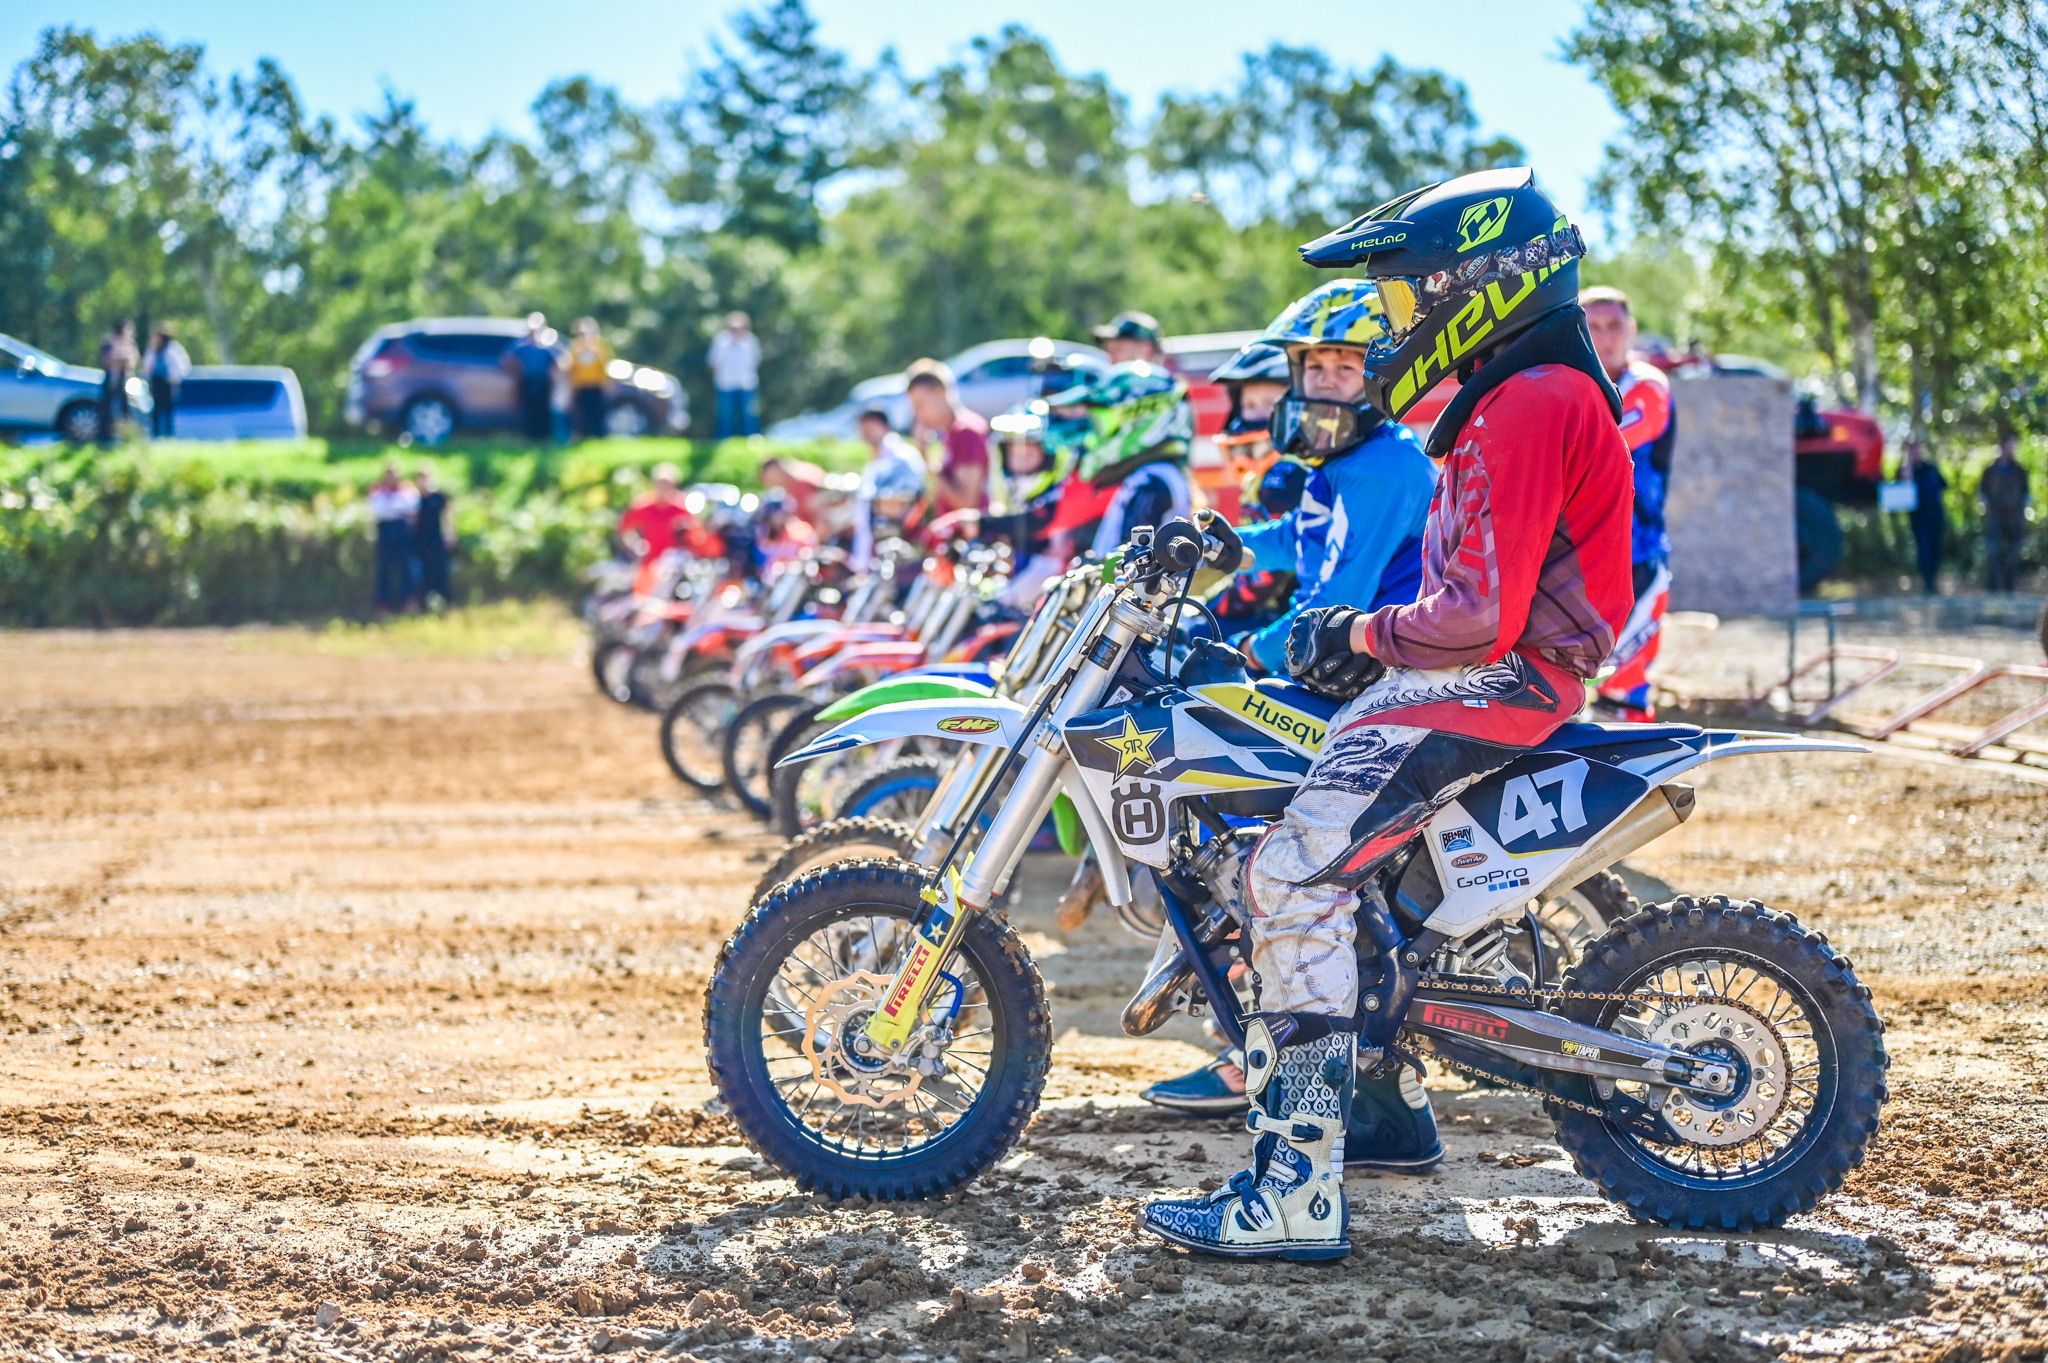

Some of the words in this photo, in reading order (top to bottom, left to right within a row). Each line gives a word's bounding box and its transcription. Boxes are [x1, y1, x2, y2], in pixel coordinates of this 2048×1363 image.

[937, 718, 999, 730] FMF
[1497, 758, 1590, 845] 47
[1457, 867, 1528, 888] GoPro
[884, 944, 931, 1018] PIRELLI
[1423, 1004, 1509, 1039] PIRELLI
